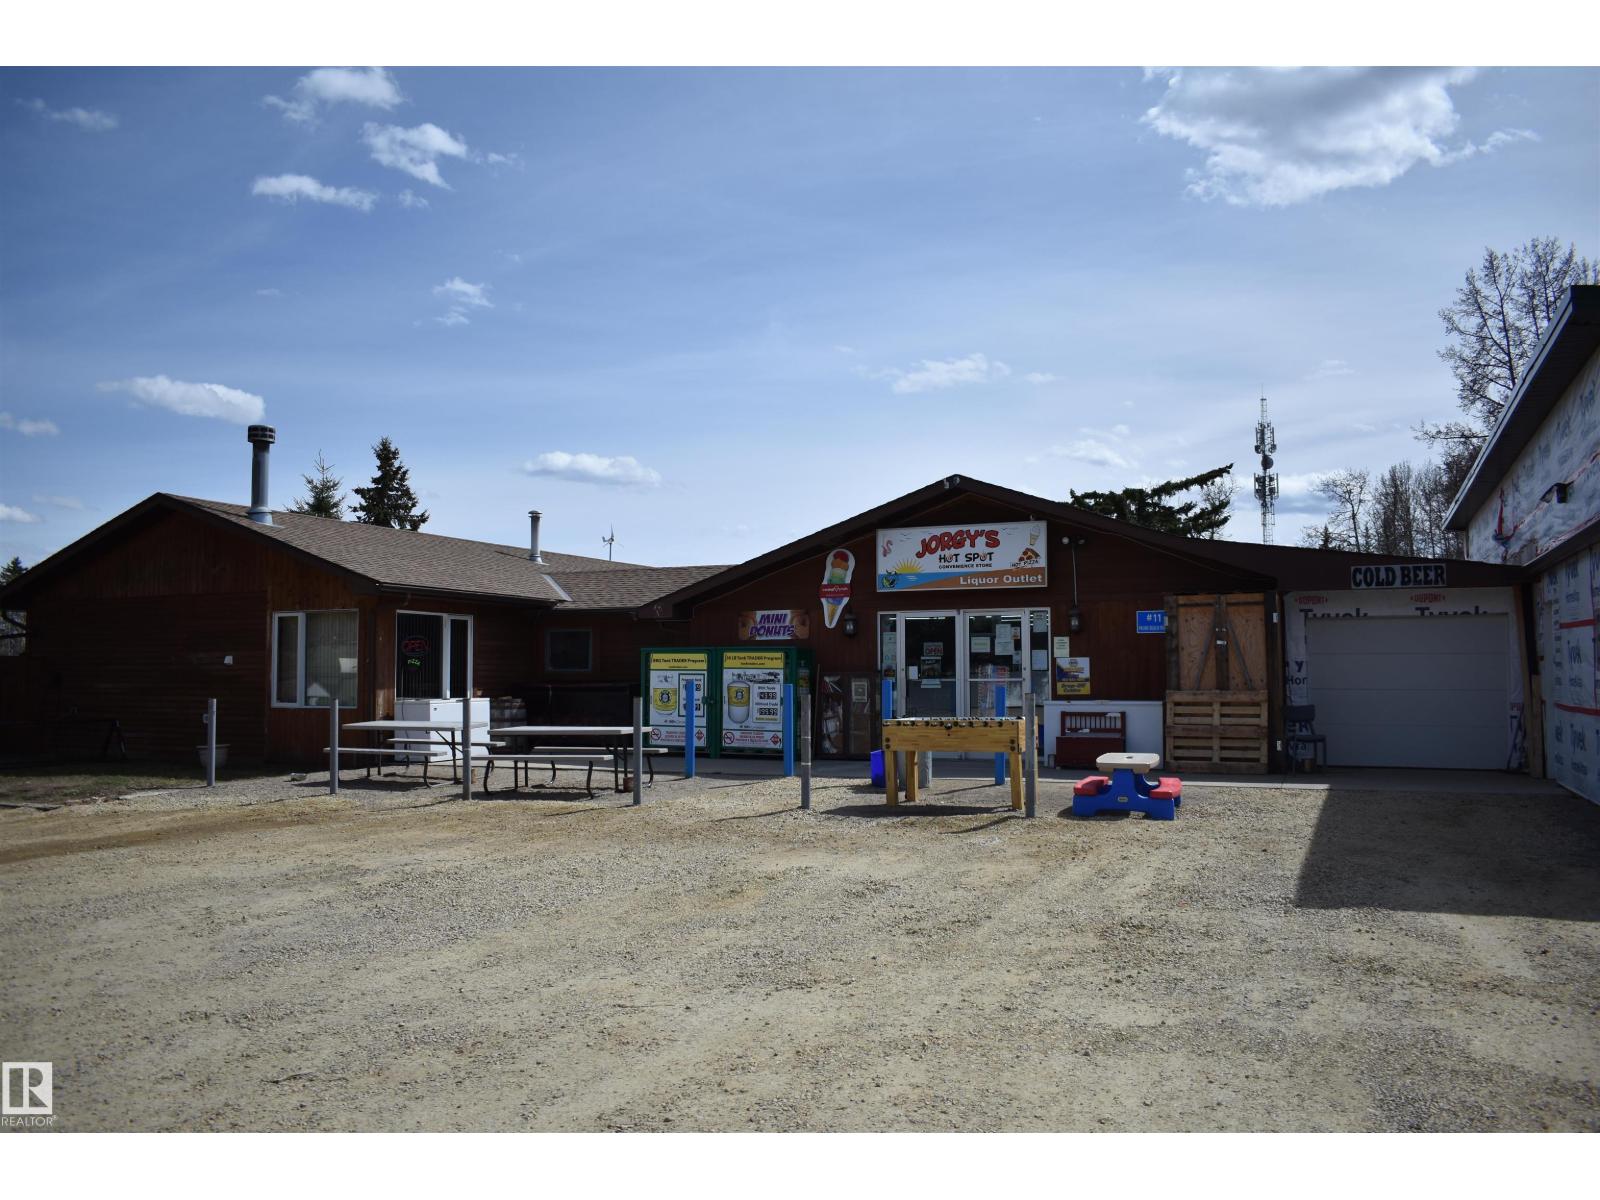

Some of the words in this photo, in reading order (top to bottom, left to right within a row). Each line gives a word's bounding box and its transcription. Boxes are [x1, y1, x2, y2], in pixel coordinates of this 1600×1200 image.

[916, 529, 1001, 558] JORGY'S
[938, 553, 960, 563] HOT
[965, 552, 995, 562] SPOT
[1023, 559, 1039, 567] PIZZA
[959, 576, 999, 586] Liquor
[1003, 574, 1043, 583] Outlet
[1352, 566, 1396, 587] COLD
[1400, 565, 1445, 586] BEER
[758, 613, 788, 625] MINI
[1146, 613, 1162, 623] #11
[749, 625, 795, 636] DONUTS
